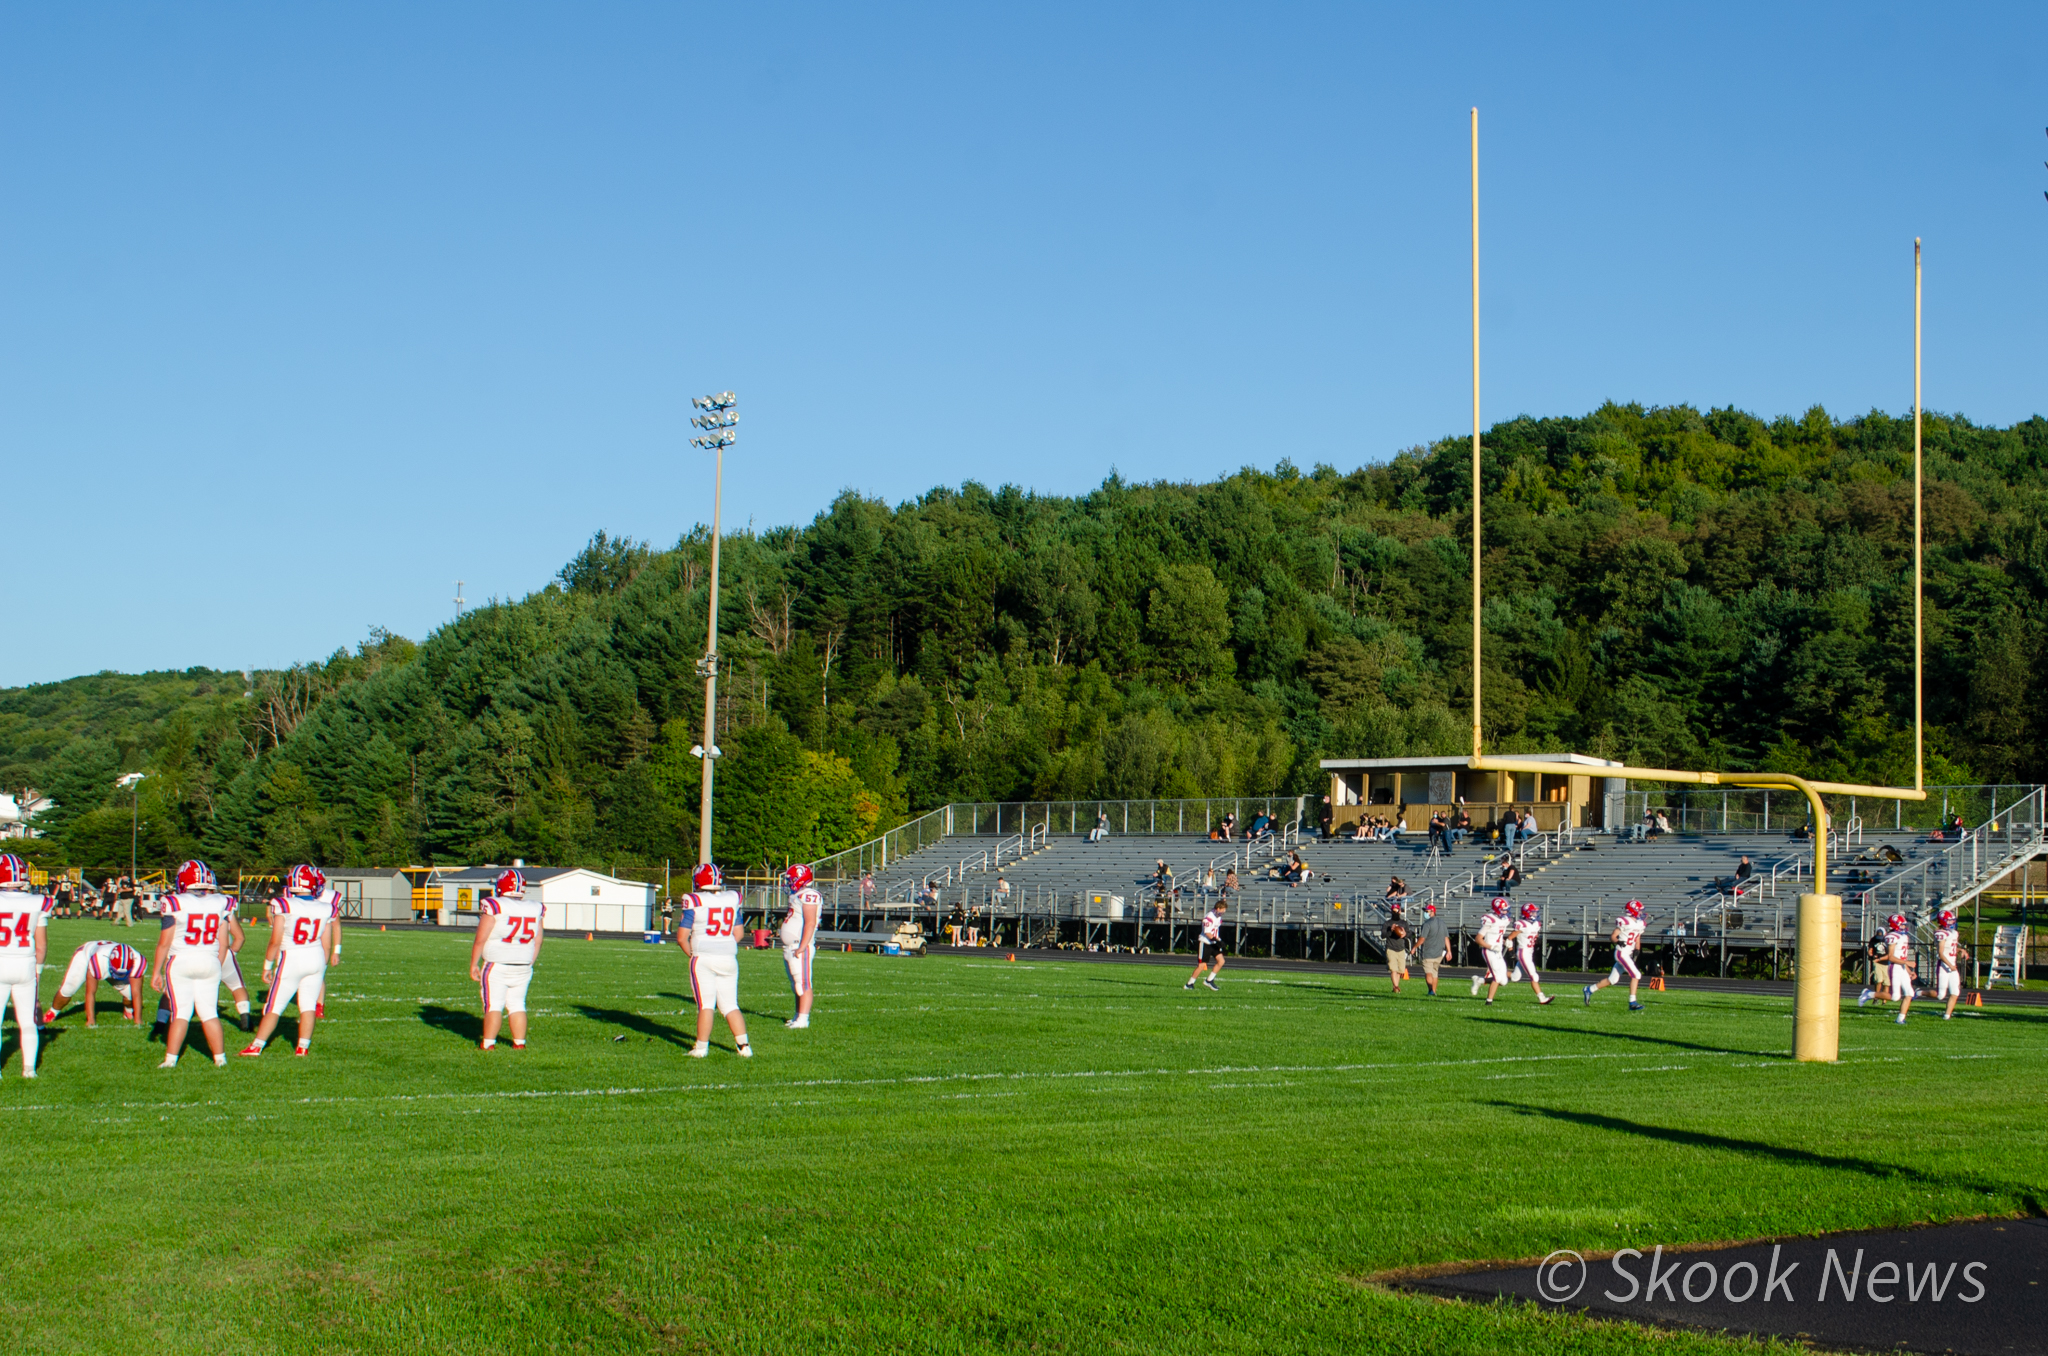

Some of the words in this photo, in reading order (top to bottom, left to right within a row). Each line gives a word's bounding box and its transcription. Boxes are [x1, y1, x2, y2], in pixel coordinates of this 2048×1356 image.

[805, 894, 818, 903] 57
[0, 912, 31, 947] 54
[184, 913, 219, 945] 58
[293, 917, 320, 945] 61
[501, 916, 536, 944] 75
[705, 907, 735, 936] 59
[1496, 930, 1504, 943] 7
[1650, 979, 1660, 989] 20
[1967, 993, 1977, 1005] 10
